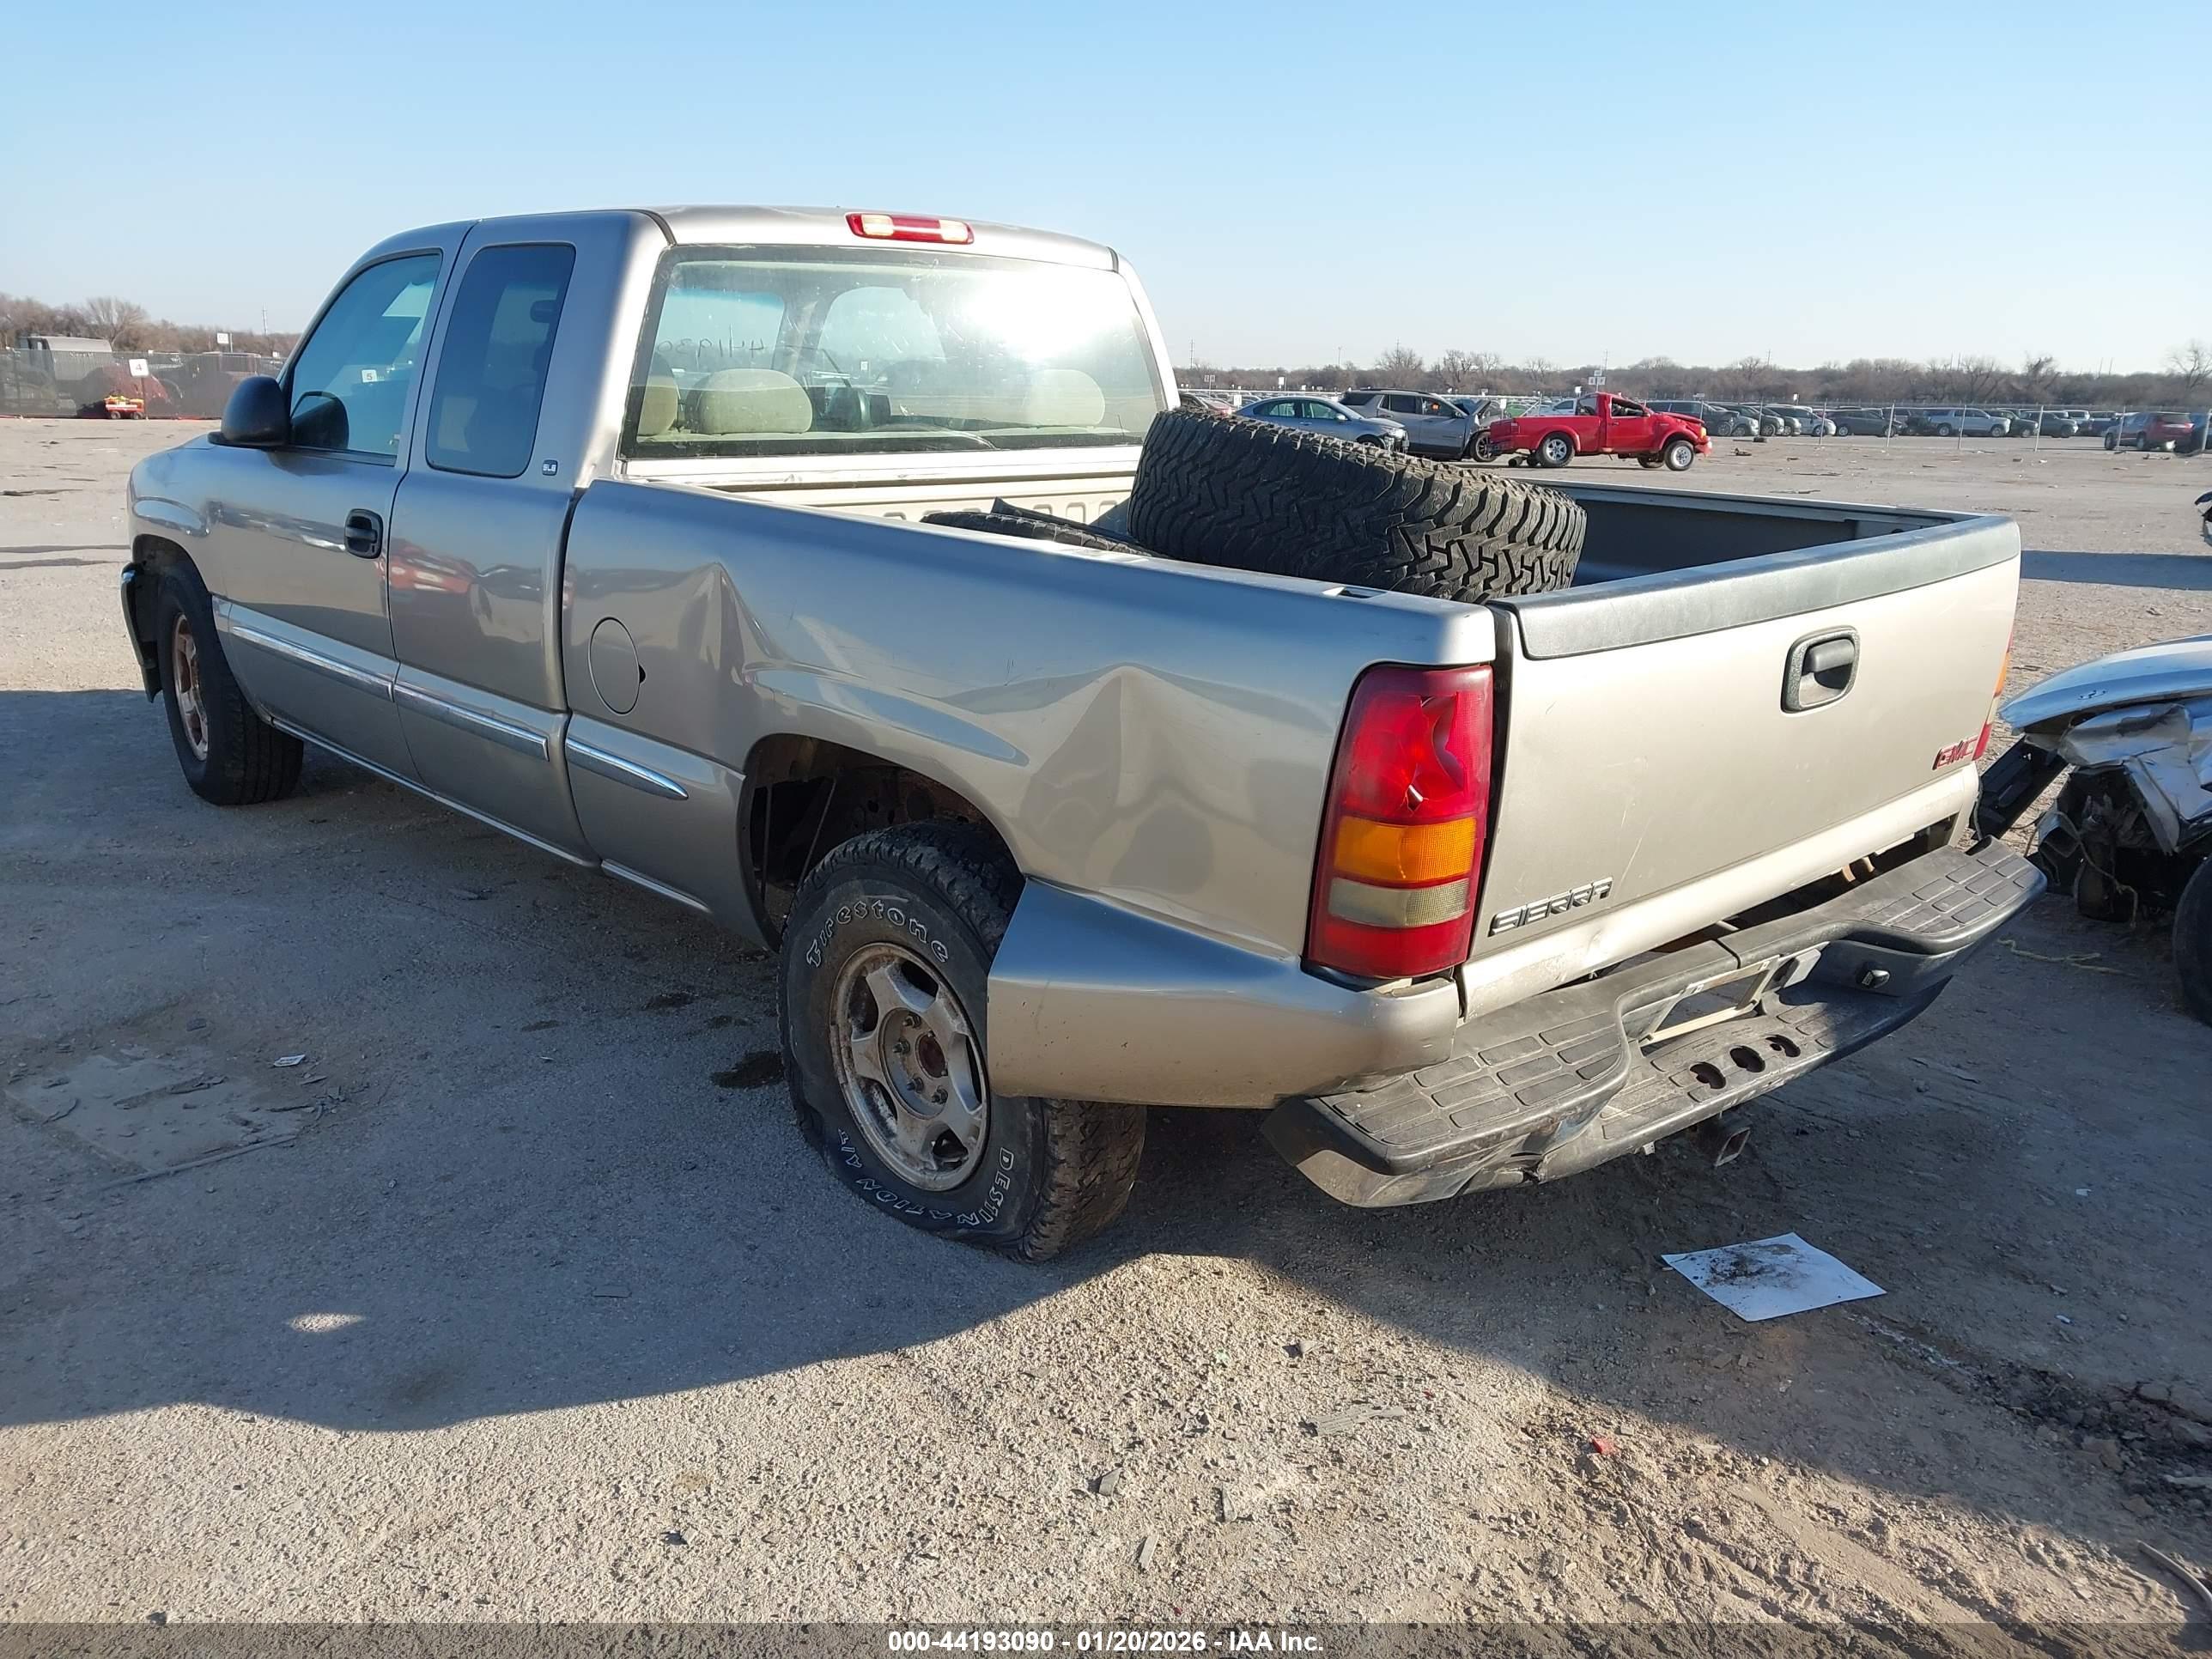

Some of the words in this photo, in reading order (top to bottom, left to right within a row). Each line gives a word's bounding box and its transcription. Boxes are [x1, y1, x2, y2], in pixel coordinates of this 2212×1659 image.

[805, 899, 949, 968] Firestone
[1487, 876, 1613, 938] SIERRA
[855, 1146, 1015, 1225] DESTINATION
